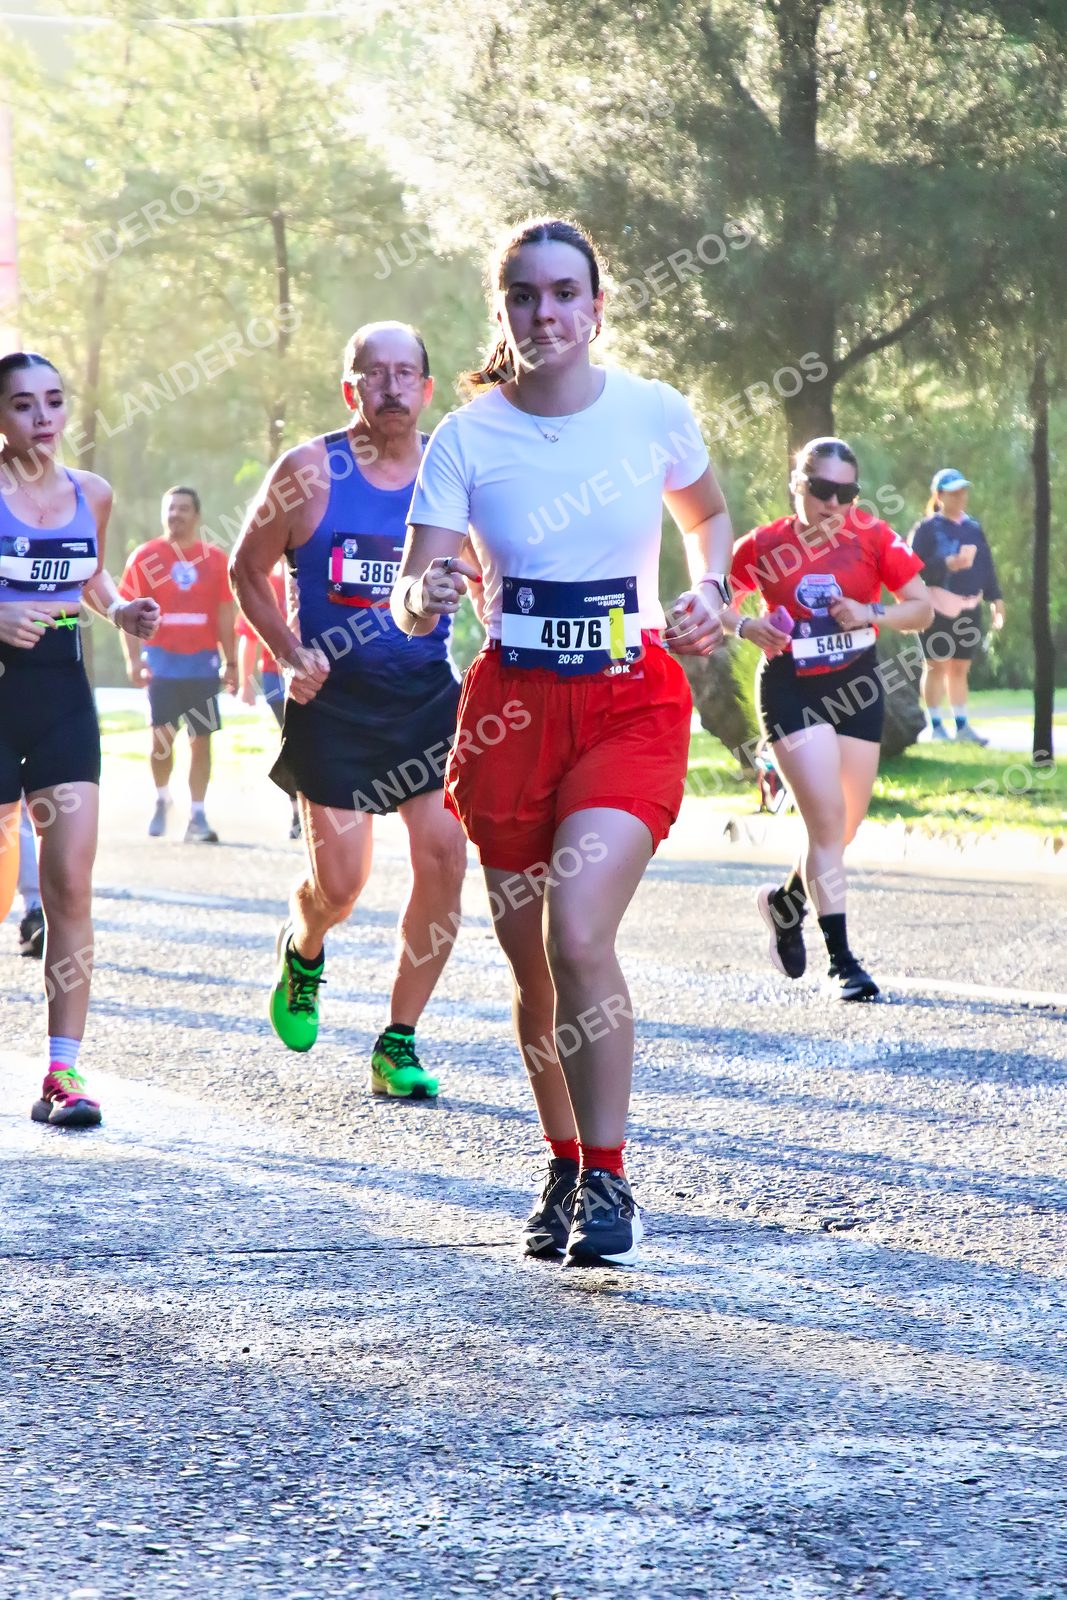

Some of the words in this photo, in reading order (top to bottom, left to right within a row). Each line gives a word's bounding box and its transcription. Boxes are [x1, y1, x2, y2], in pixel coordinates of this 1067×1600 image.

[30, 559, 70, 580] 5010
[541, 619, 601, 648] 4976
[816, 633, 853, 654] 5440
[610, 664, 631, 674] 10K
